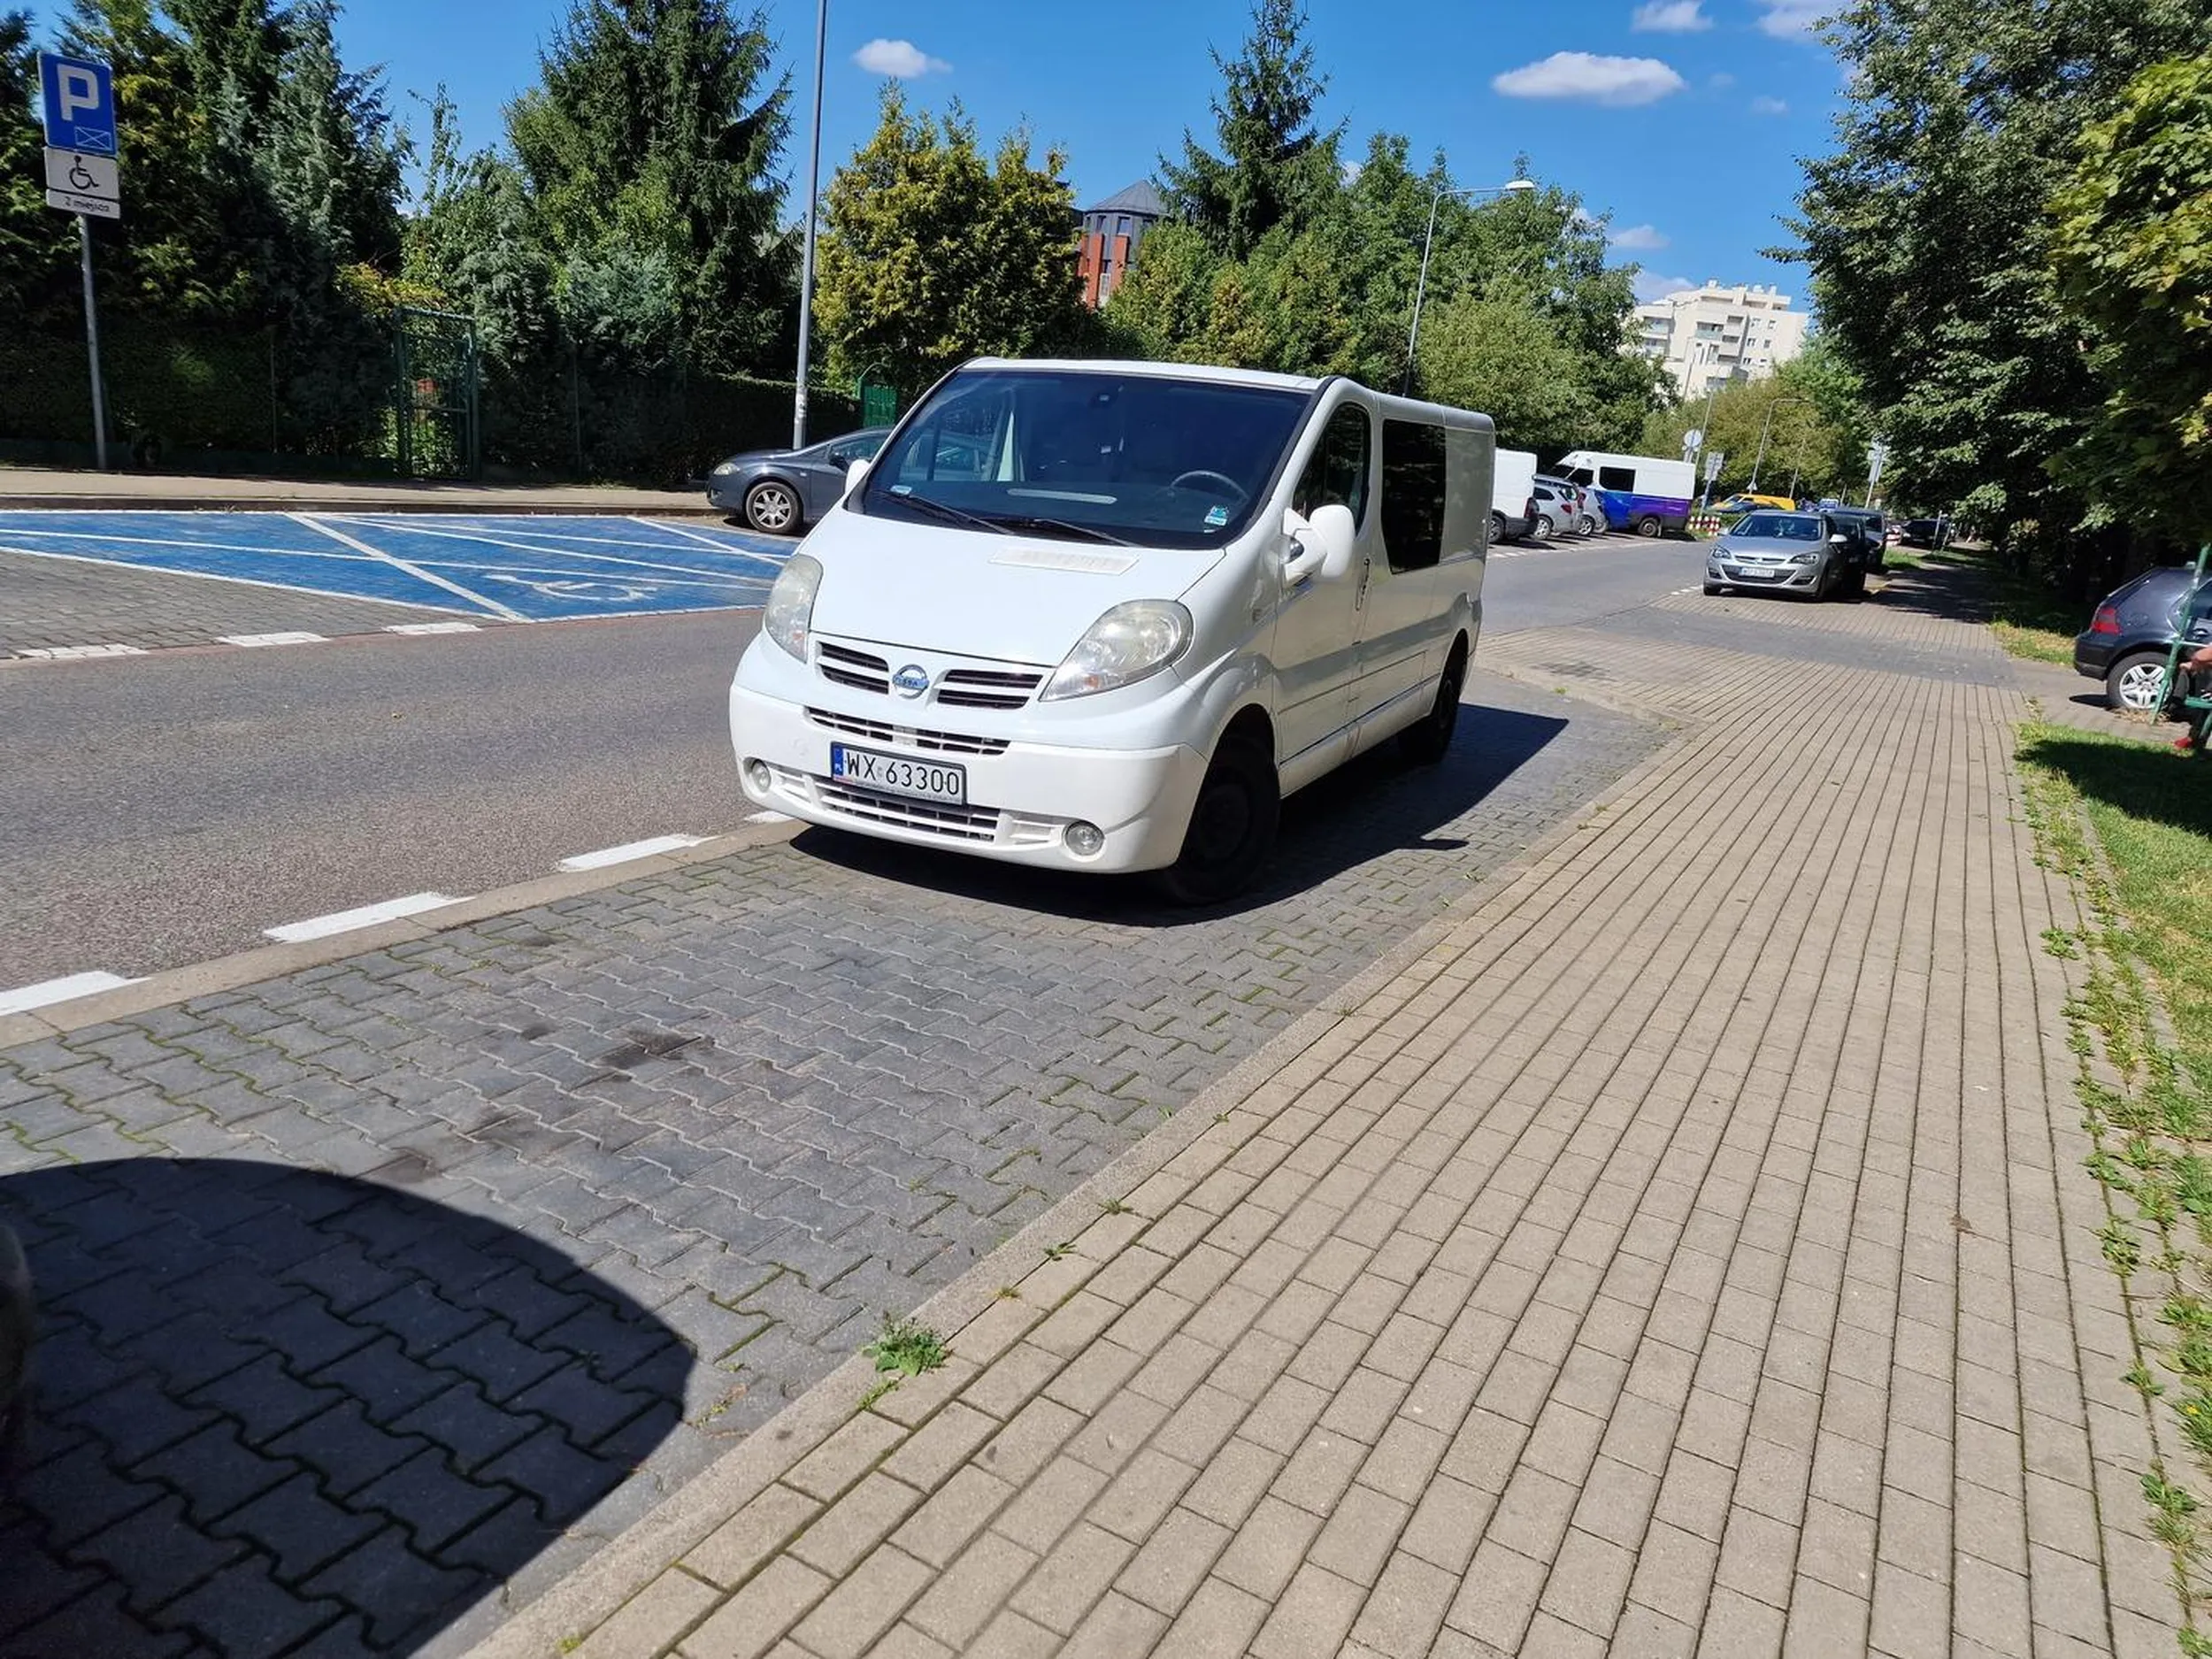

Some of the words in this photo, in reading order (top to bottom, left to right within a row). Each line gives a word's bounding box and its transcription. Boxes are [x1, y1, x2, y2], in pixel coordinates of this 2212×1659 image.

[57, 63, 100, 121] P
[846, 751, 876, 780] WX
[886, 761, 959, 795] 63300
